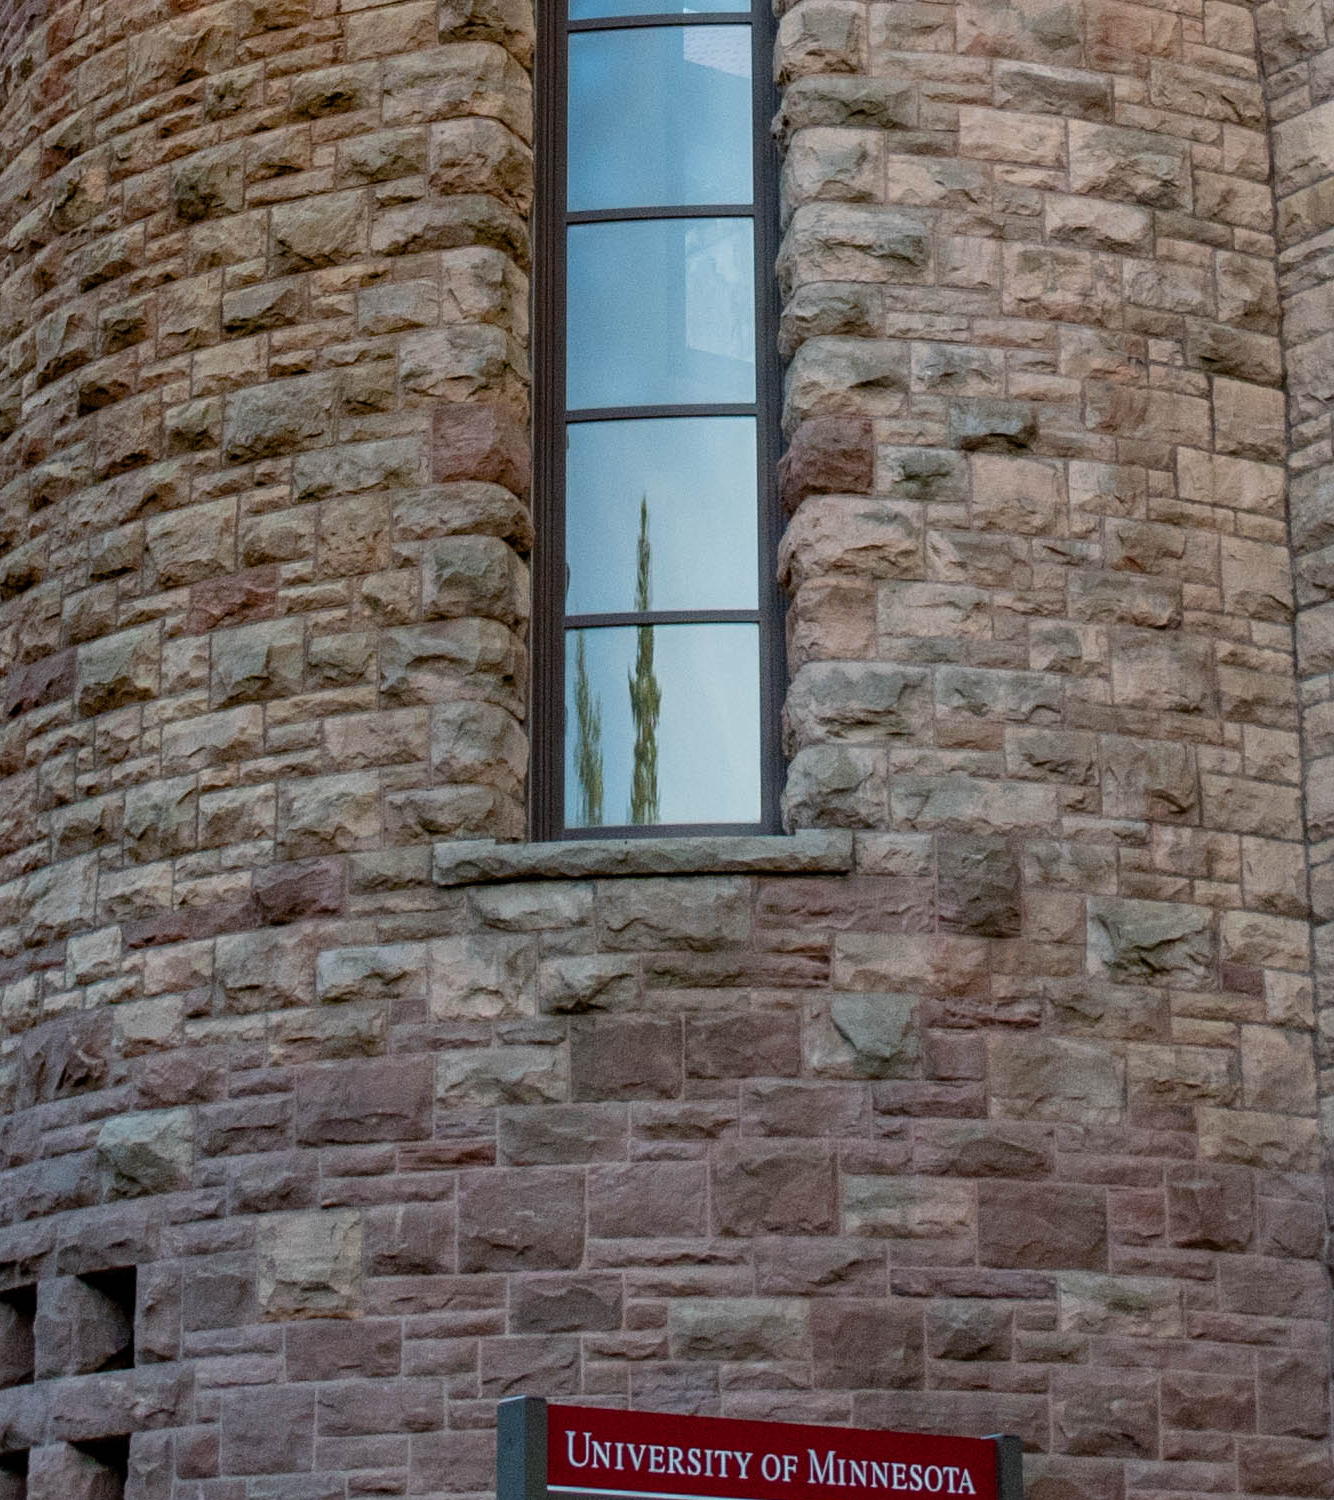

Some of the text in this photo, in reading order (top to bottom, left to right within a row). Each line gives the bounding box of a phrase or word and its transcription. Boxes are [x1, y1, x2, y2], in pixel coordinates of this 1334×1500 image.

[566, 1430, 977, 1496] UNIVERSITY OF MINNESOTA
